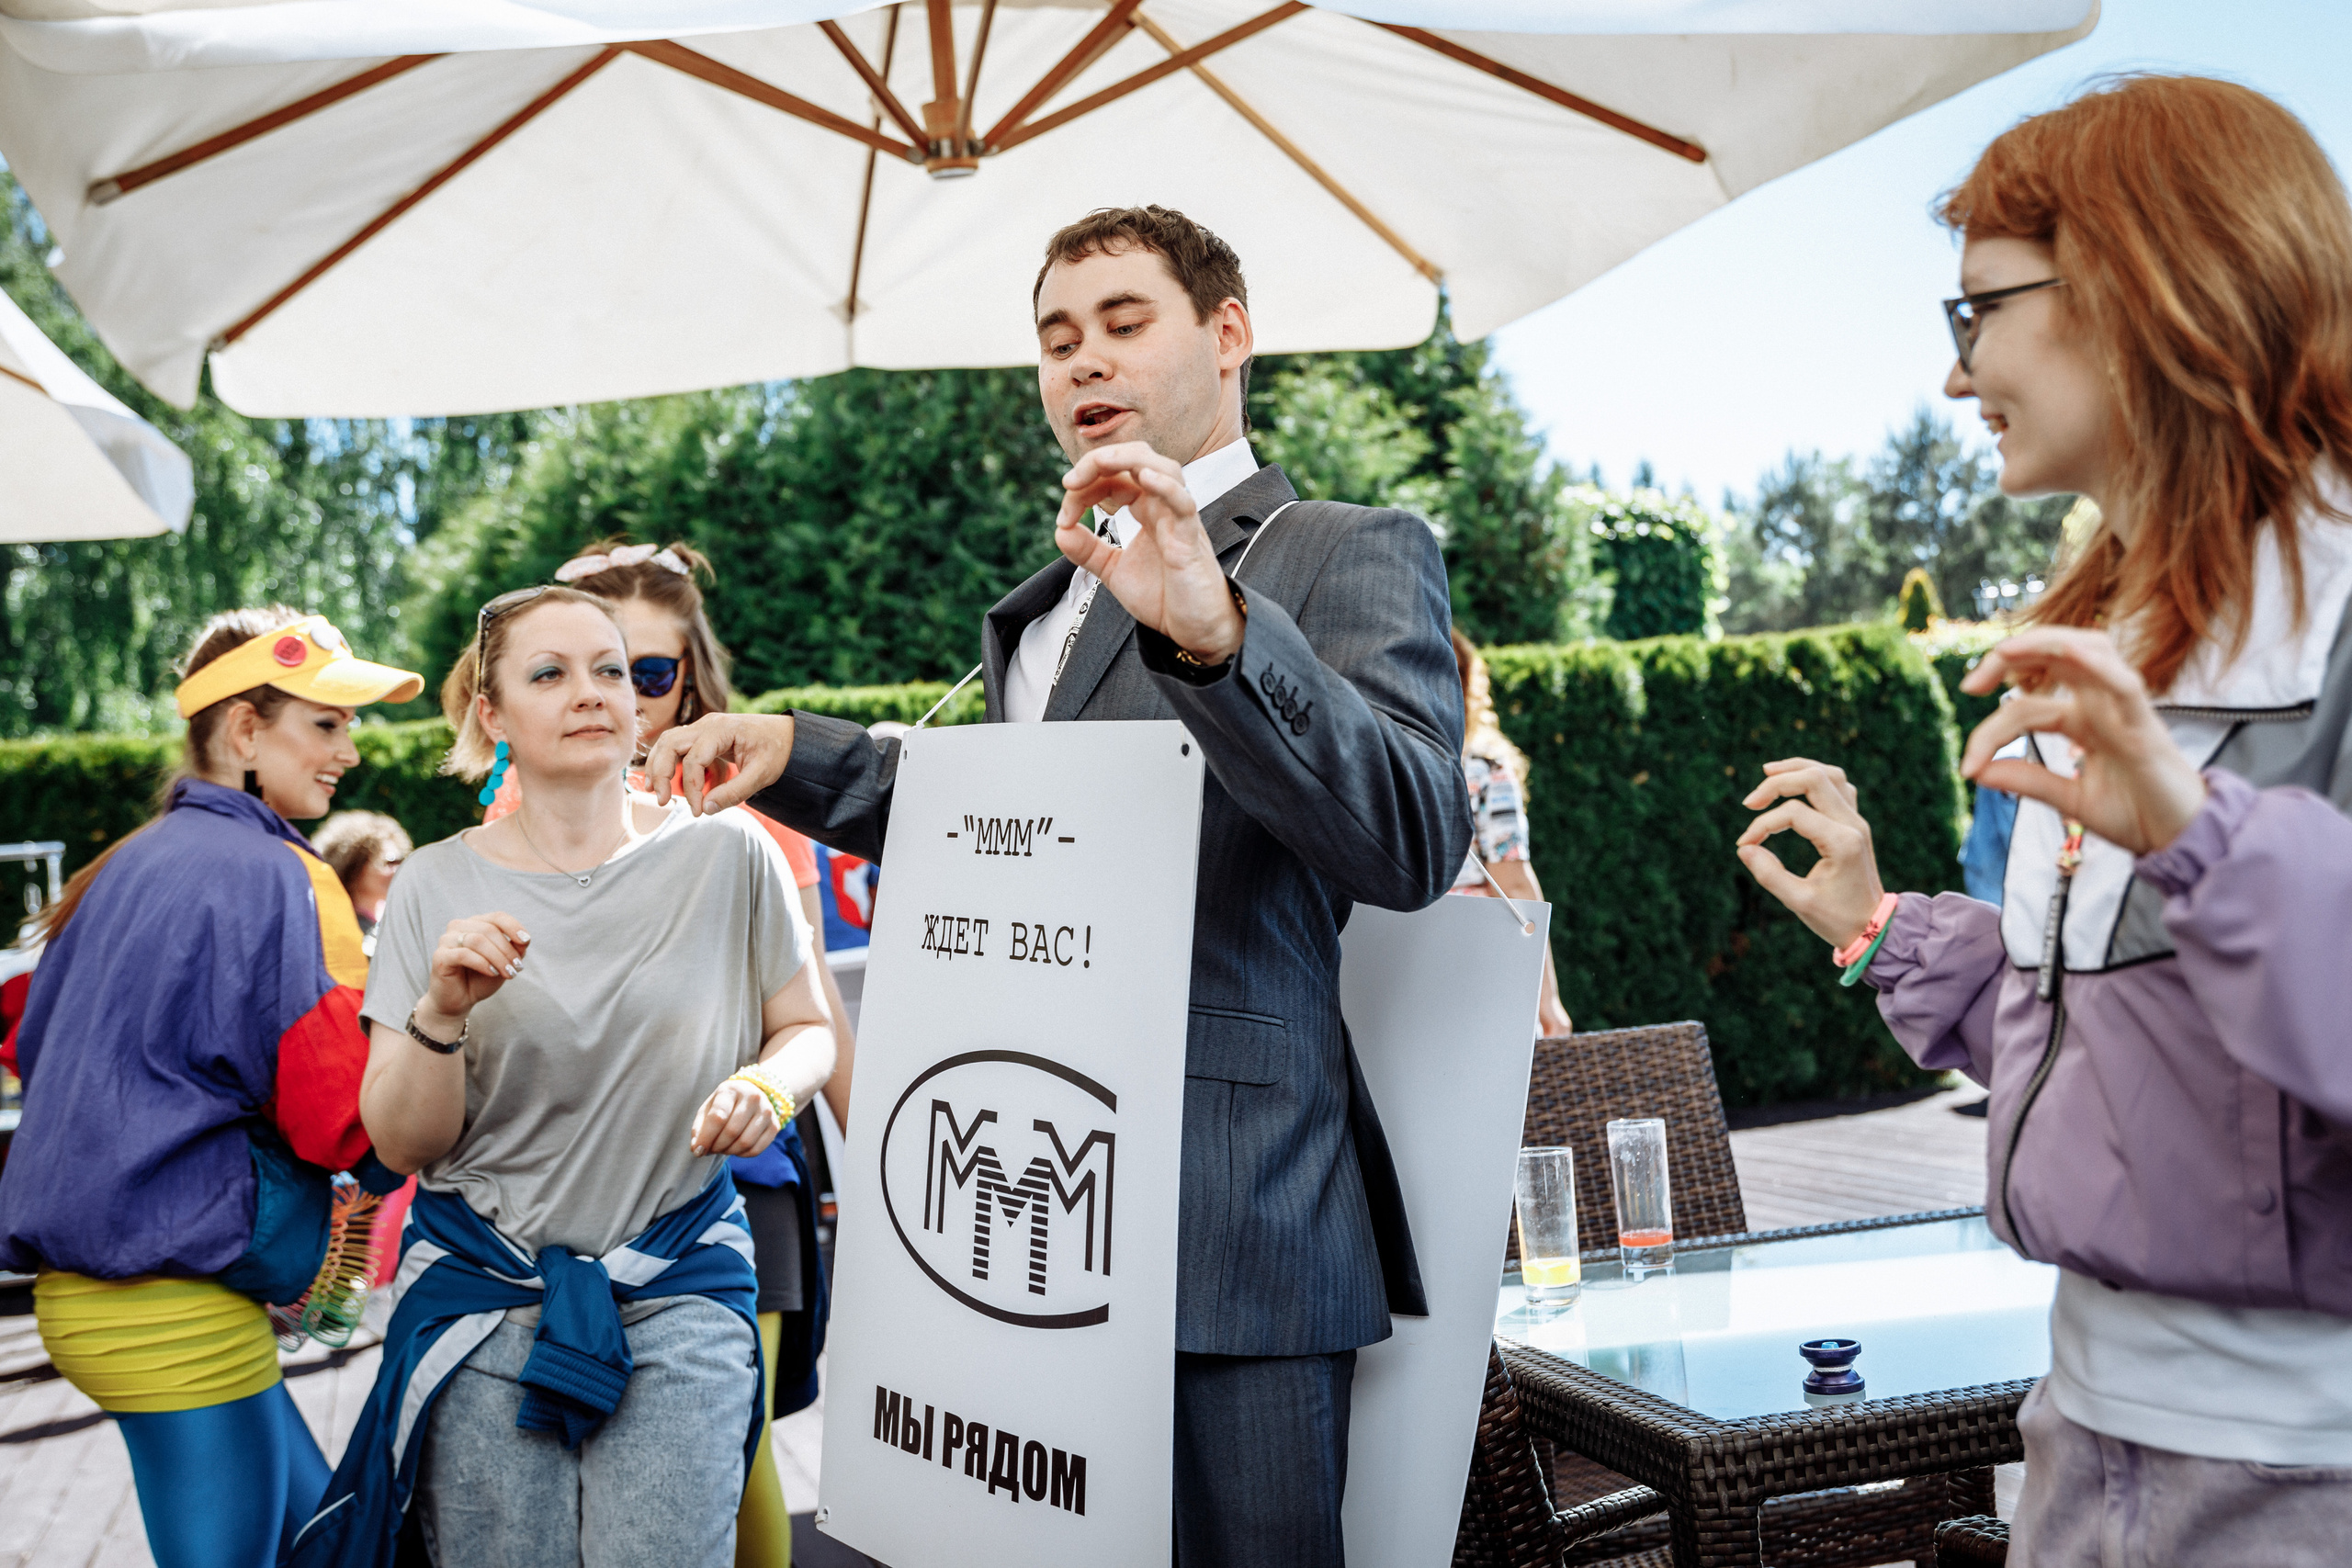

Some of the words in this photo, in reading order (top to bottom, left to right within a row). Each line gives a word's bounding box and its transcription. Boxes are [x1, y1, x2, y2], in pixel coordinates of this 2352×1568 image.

[921, 913, 989, 961] ЖДЕТ
[1009, 921, 1092, 969] ВАС!
[873, 1384, 935, 1461] МЫ
[942, 1411, 1087, 1517] РЯДОМ
